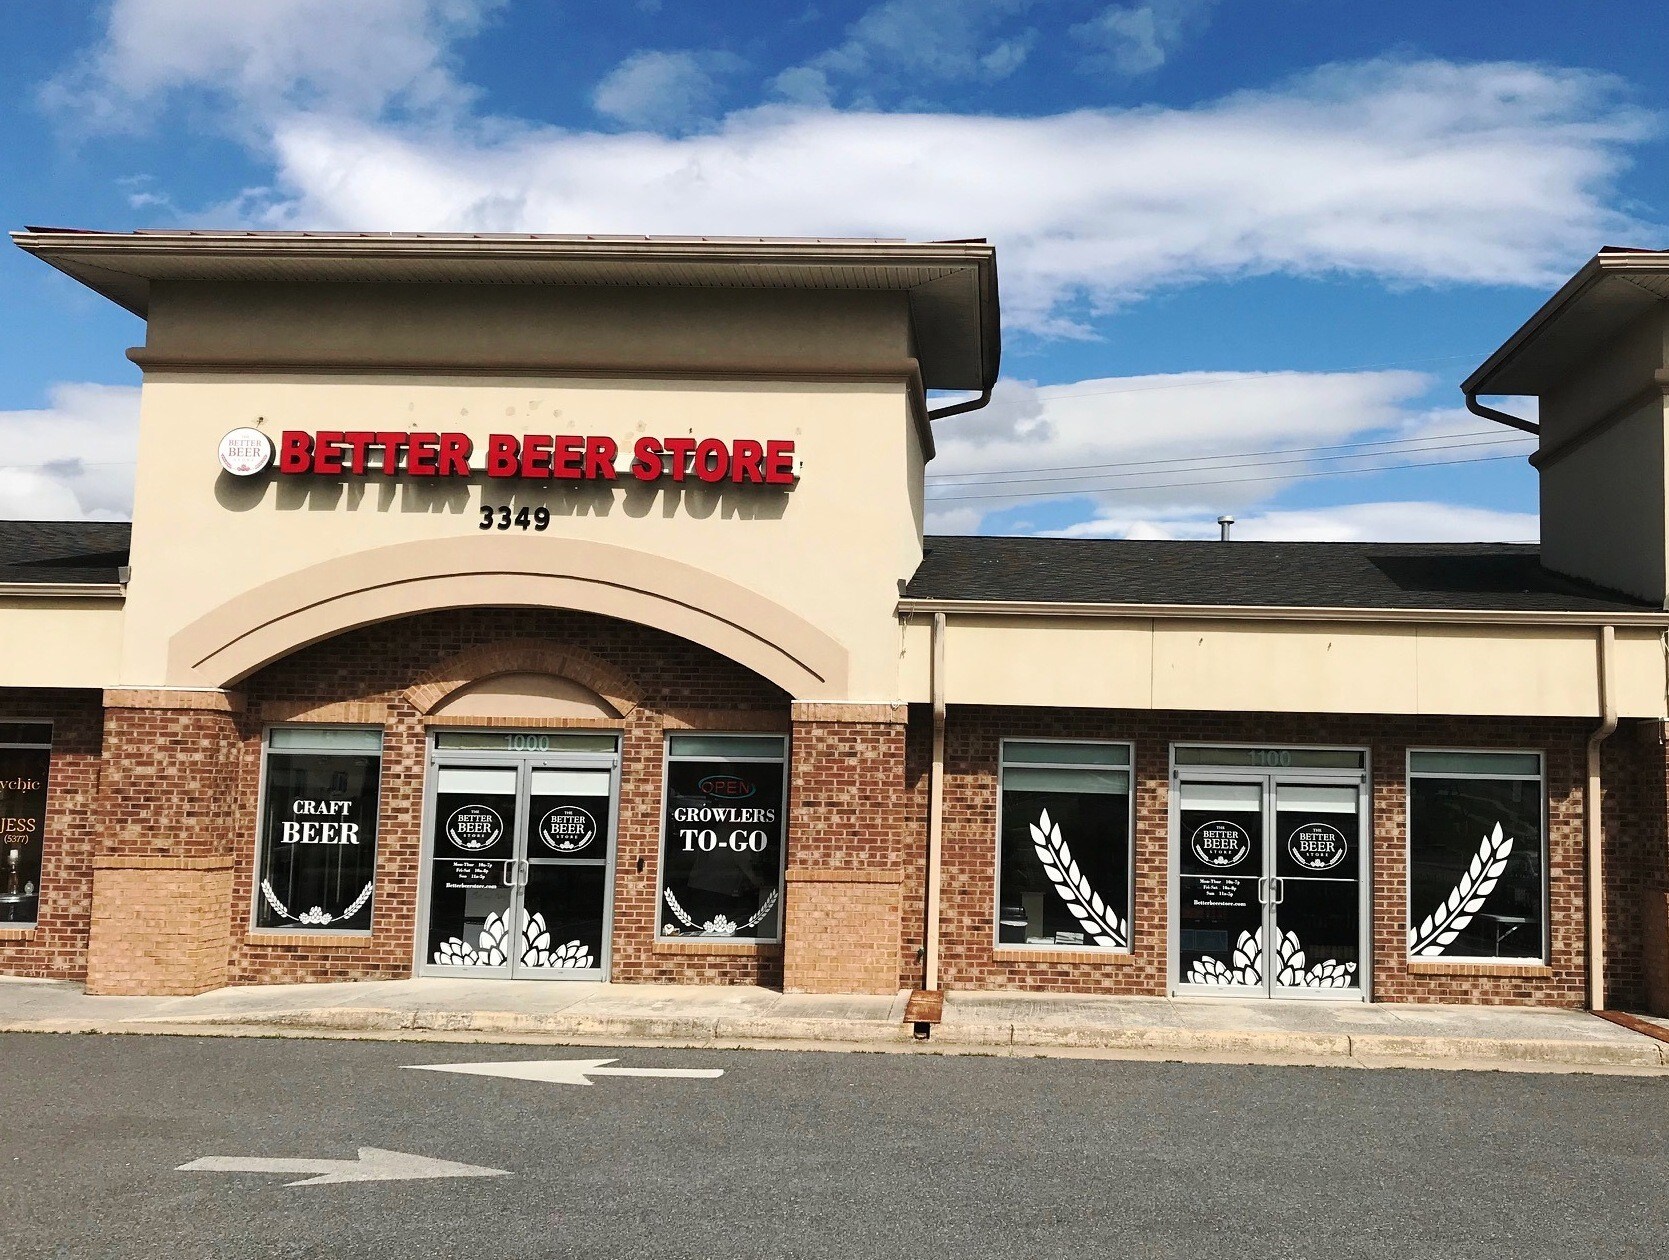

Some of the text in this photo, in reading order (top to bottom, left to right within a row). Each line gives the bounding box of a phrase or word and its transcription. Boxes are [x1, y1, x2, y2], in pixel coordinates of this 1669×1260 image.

[228, 447, 261, 457] BEER
[280, 431, 796, 485] BETTER BEER STORE
[479, 505, 551, 531] 3349
[504, 734, 550, 752] 1000
[1247, 750, 1291, 767] 1100
[701, 781, 750, 794] OPEN
[293, 800, 352, 815] CRAFT
[551, 815, 586, 824] BETTER
[674, 807, 776, 823] GROWLERS
[280, 821, 360, 844] BEER
[457, 822, 491, 833] BEER
[550, 824, 585, 834] BEER
[4, 834, 29, 844] (5377)
[679, 829, 768, 852] TO-GO
[1203, 831, 1239, 839] BETTER
[1300, 833, 1336, 842] BETTER
[1203, 838, 1238, 850] BEER
[1300, 841, 1336, 852] BEER
